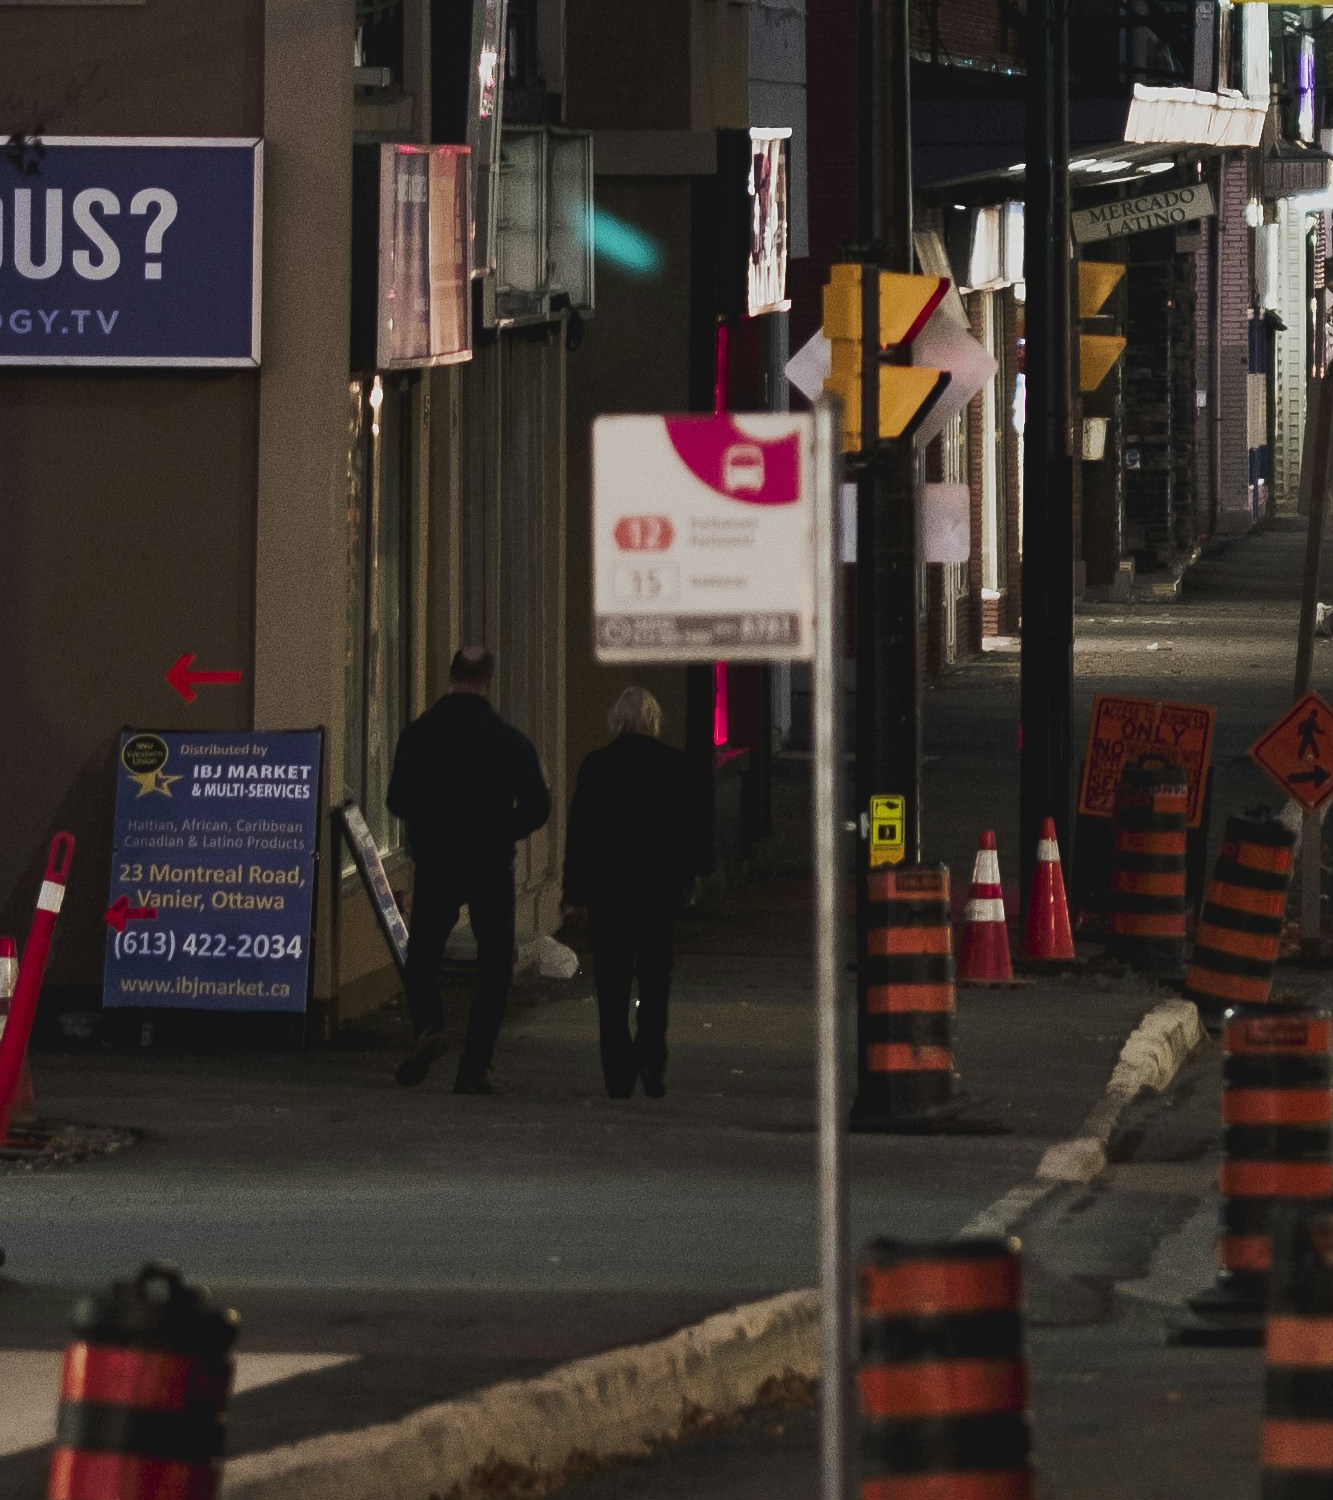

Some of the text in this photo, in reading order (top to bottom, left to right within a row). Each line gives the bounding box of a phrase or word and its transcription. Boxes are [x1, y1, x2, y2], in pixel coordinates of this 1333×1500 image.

[1089, 188, 1195, 224] MERCADO
[1105, 207, 1186, 237] LATINO
[0, 187, 179, 281] US?
[0, 309, 120, 335] GY.TV
[1121, 719, 1186, 746] ONLY
[180, 744, 268, 758] Distributed by
[193, 764, 312, 780] IBJ MARKET
[191, 783, 311, 799] & MULTI-SERVICES
[128, 819, 303, 834] Haitian, African, Caribbean
[124, 835, 184, 847] Canadian
[203, 835, 243, 848] Latino
[247, 835, 305, 849] Products
[119, 864, 305, 888] 23 Montreal Road,
[137, 889, 286, 912] Vanier, Ottawa
[114, 930, 303, 962] (613) 422-2034
[120, 975, 291, 998] www.ibjmarket.ca
